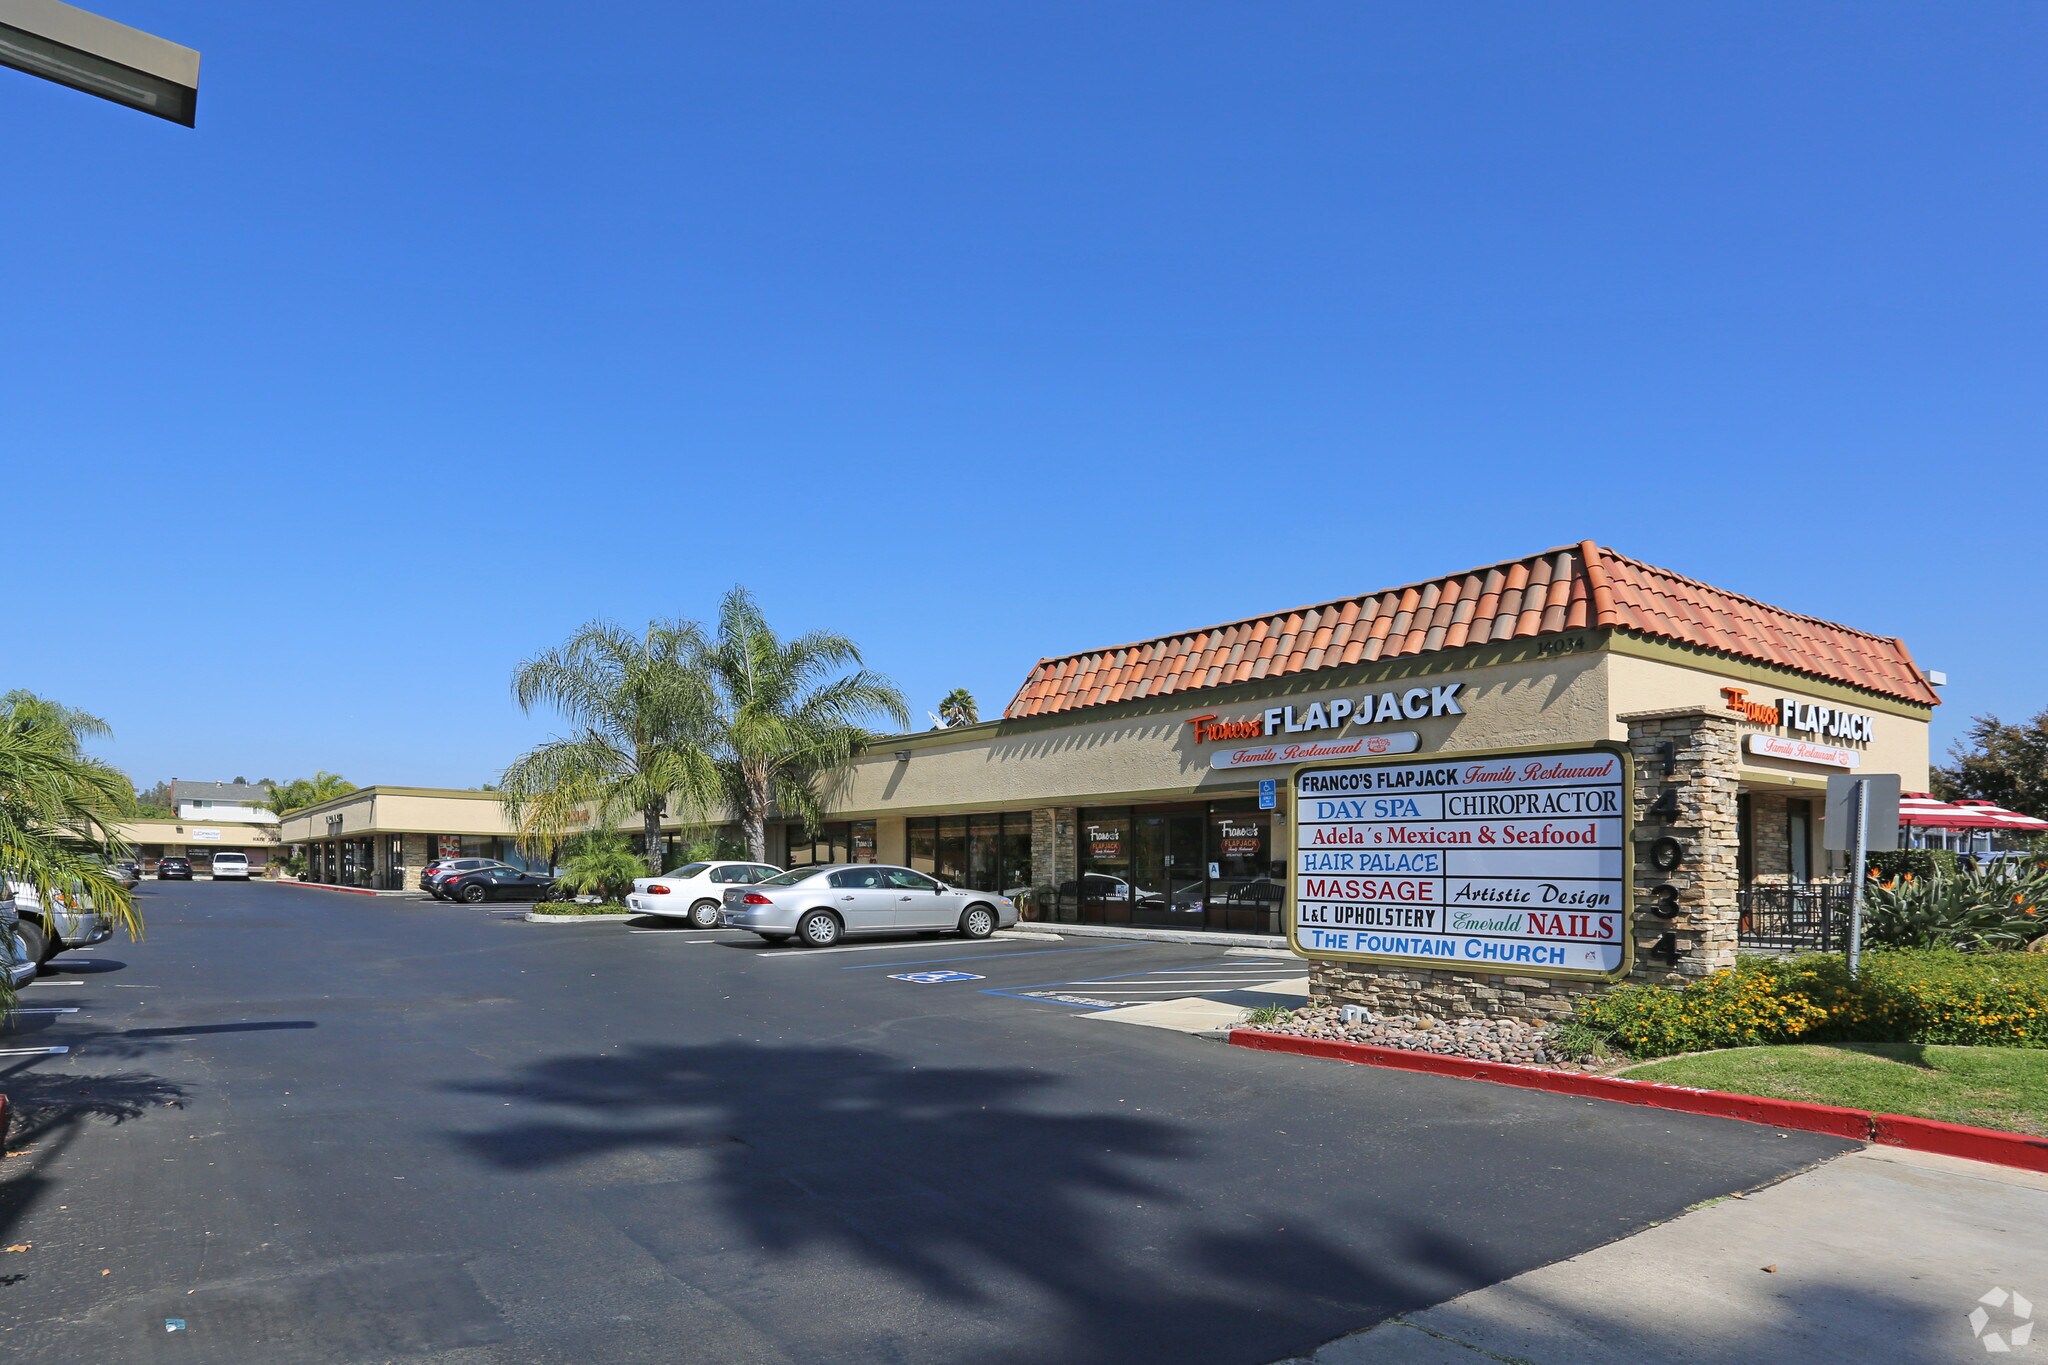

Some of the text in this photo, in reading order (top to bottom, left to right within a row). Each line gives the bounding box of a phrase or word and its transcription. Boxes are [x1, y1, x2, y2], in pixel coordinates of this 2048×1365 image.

[1264, 683, 1466, 736] FLAPJACK
[1780, 698, 1876, 742] FLAPJACK
[1230, 739, 1364, 765] Family Restaurant
[1763, 738, 1838, 762] Family Restaurant
[1302, 760, 1615, 792] FRANCO'S FLAPJACK Family Restaurant
[1316, 798, 1422, 819] DAY SPA
[1449, 791, 1618, 816] CHIROPRACTOR
[1224, 839, 1257, 847] FLAPJACK
[1386, 826, 1472, 844] Mexican
[1477, 825, 1497, 845] &
[1502, 823, 1597, 844] Seafood
[1211, 864, 1217, 873] A
[1304, 853, 1439, 872] HAIR PALACE
[1306, 879, 1434, 901] MASSAGE
[1454, 882, 1611, 908] Artistic Design
[1302, 905, 1436, 928] L&C UPHOLSTERY
[1452, 911, 1614, 939] Emerald NAILS
